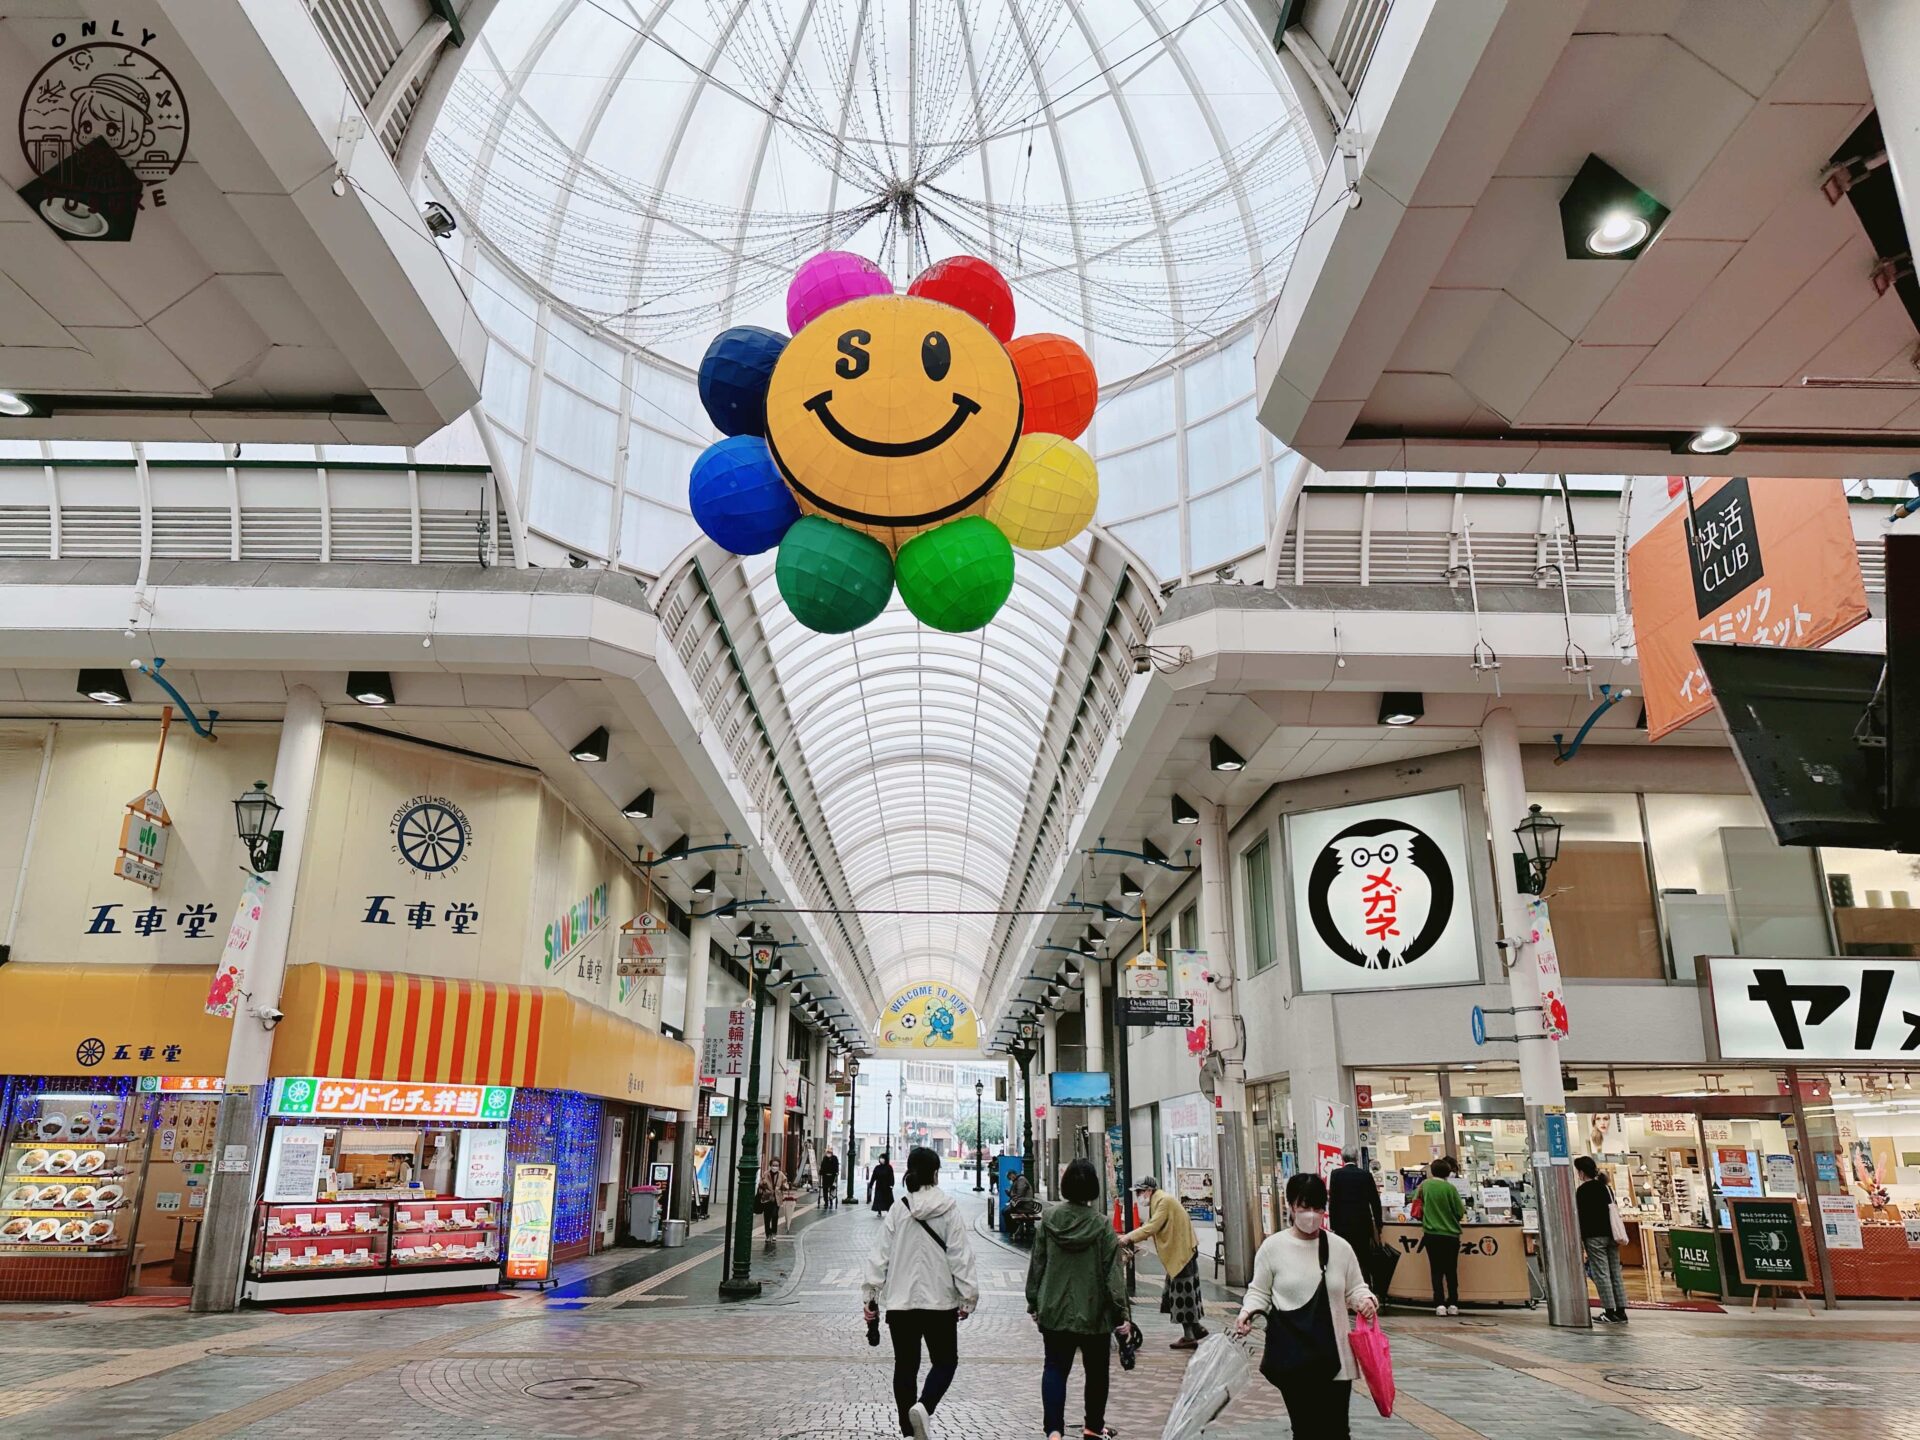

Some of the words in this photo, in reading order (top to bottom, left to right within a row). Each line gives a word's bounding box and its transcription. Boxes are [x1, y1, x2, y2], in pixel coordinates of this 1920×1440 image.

[1697, 498, 1744, 562] 快活
[1702, 542, 1749, 592] CLUB
[389, 795, 432, 828] TONKATU
[438, 797, 473, 840] SANDWICH
[390, 845, 469, 880] GOSHADO
[84, 903, 218, 938] 五車堂
[360, 894, 479, 935] 五車堂
[1362, 866, 1402, 941] メガネ
[544, 882, 607, 971] SANDWICH
[890, 986, 933, 1013] WELCOME
[937, 987, 948, 997] TO
[950, 994, 968, 1015] OITA
[112, 1045, 182, 1063] 五車堂
[726, 1010, 746, 1075] 駐輪禁止
[180, 1077, 225, 1090] 五車堂
[1651, 1119, 1686, 1132] 抽選会
[470, 1171, 500, 1179] サンドイッチ
[1678, 1246, 1709, 1263] TALEX
[1755, 1257, 1792, 1267] TALEX
